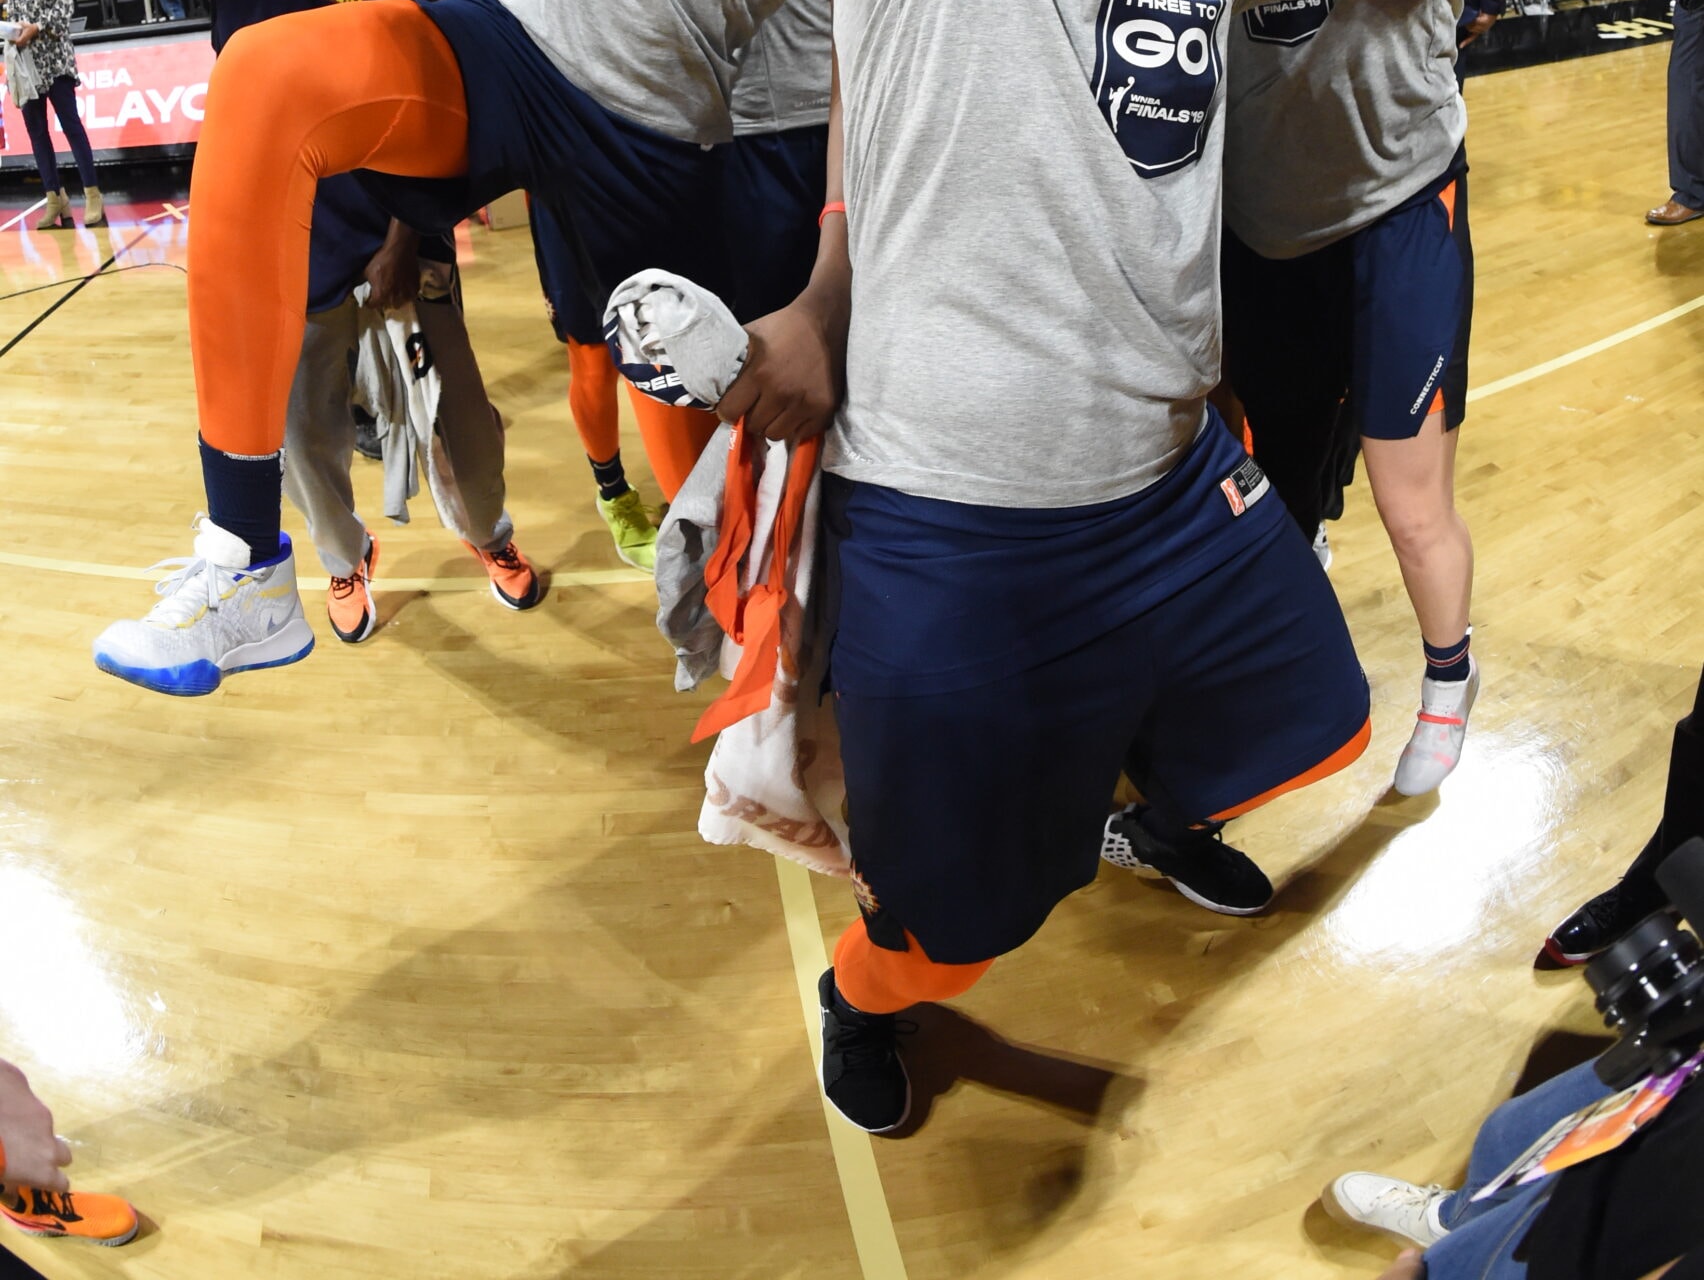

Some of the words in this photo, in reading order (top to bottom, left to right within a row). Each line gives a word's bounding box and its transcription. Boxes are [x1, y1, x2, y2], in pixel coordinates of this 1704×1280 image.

[1196, 3, 1217, 20] TO
[1112, 19, 1209, 76] GO
[78, 67, 133, 91] NBA
[1130, 93, 1161, 106] WNBA
[631, 372, 681, 392] REE
[1410, 354, 1445, 415] CONNECTICUT
